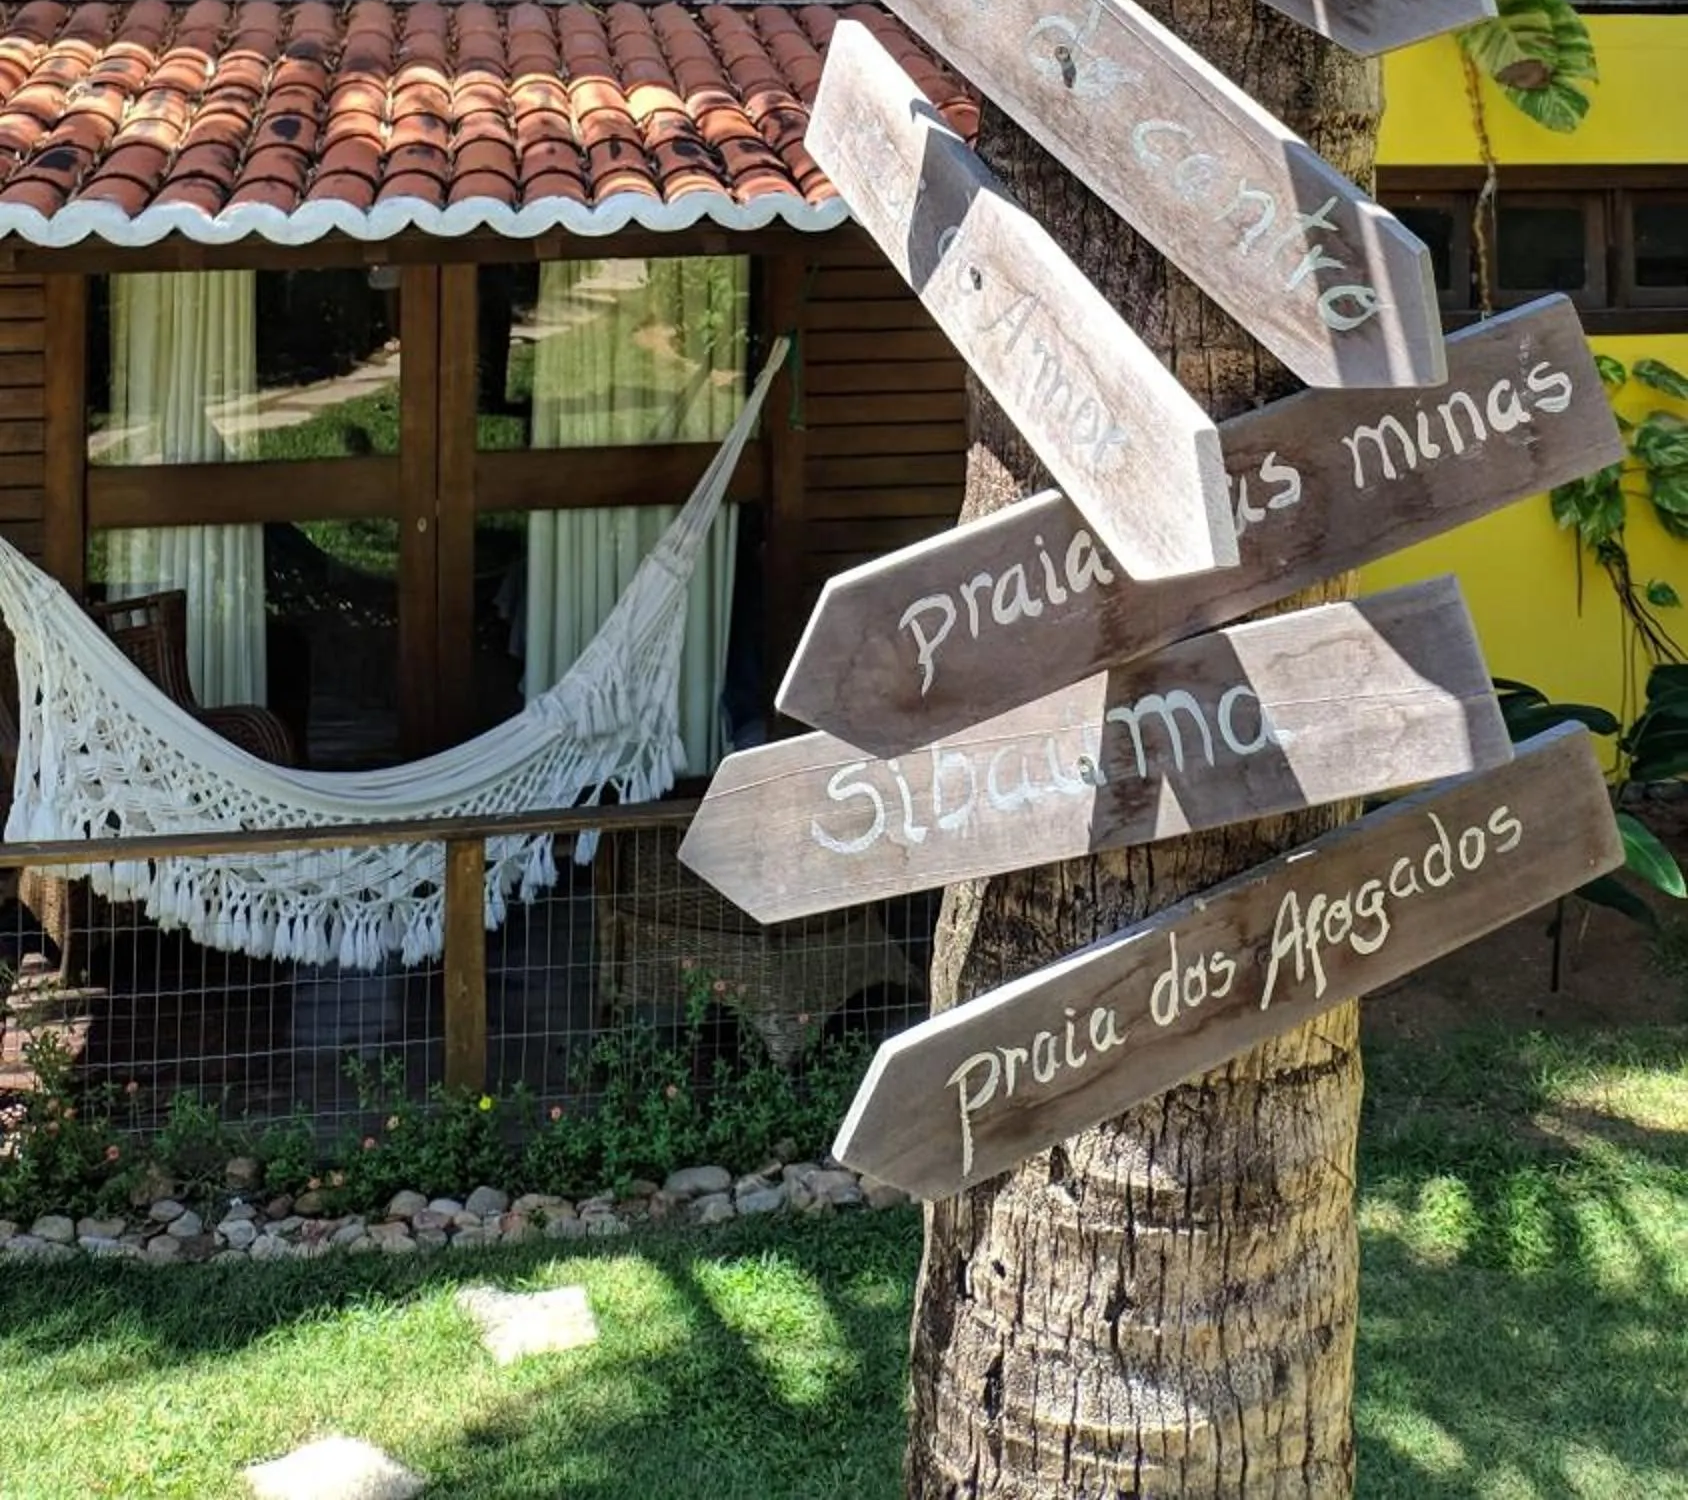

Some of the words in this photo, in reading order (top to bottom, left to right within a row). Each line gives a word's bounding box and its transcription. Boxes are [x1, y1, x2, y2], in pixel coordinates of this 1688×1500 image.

[1342, 361, 1573, 489] minas
[1151, 932, 1236, 1028] dos
[1260, 805, 1522, 1011] Afogados
